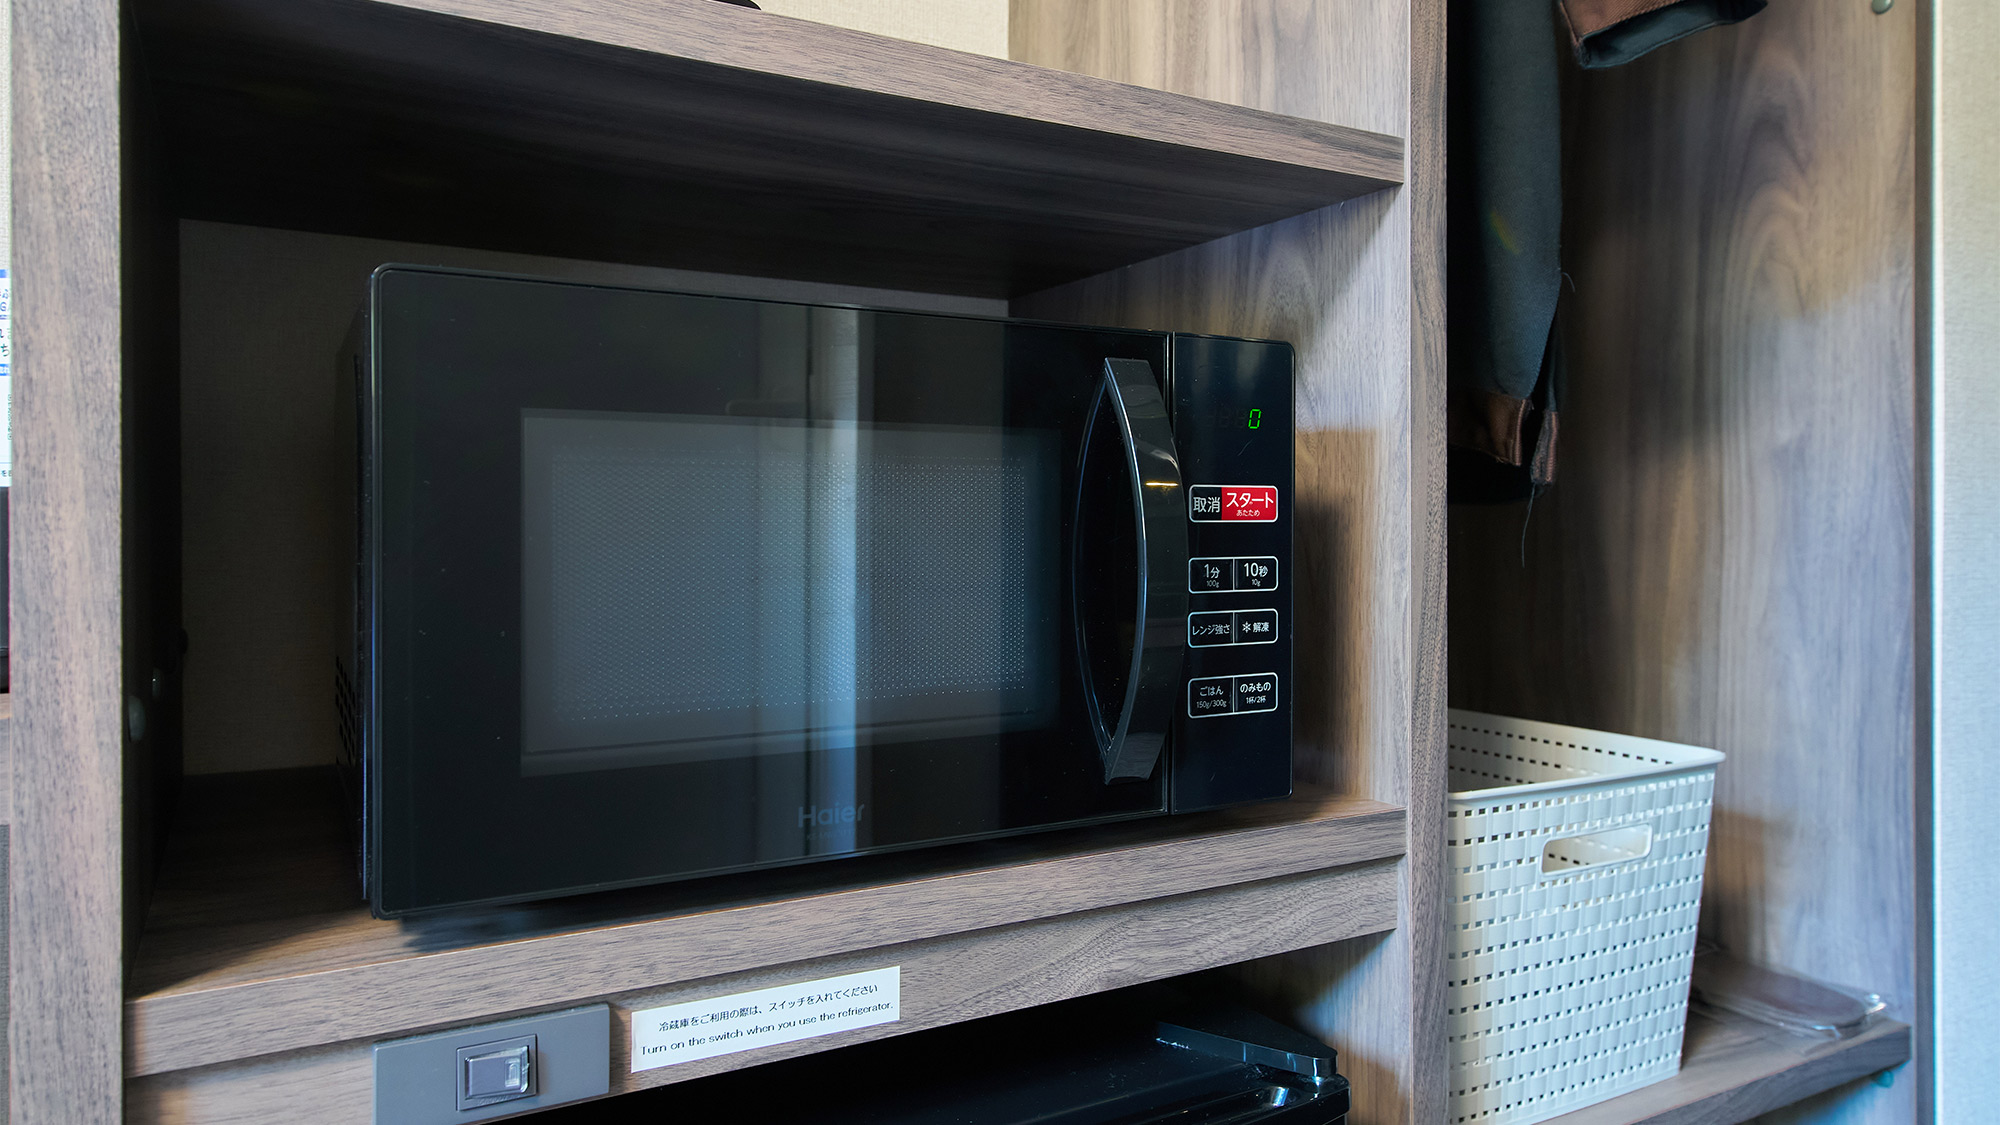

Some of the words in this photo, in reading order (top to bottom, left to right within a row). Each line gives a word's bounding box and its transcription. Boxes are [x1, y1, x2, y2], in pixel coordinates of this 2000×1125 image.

[1248, 409, 1261, 429] 0
[1193, 496, 1220, 513] 取消
[1226, 492, 1274, 508] スタート
[1236, 509, 1260, 517] あたため
[1203, 563, 1220, 579] 1分
[1243, 562, 1269, 578] 10秒
[1206, 580, 1219, 588] 100g
[1251, 578, 1261, 587] 10g
[1192, 624, 1231, 636] レンジ強さ
[1199, 685, 1224, 697] ごはん
[1239, 681, 1272, 694] のみもの
[1196, 699, 1227, 710] 150g/300g
[1245, 694, 1267, 705] 1杯/2杯
[798, 802, 865, 828] Haier
[641, 1043, 667, 1055] Turn
[670, 1040, 685, 1050] on
[688, 1036, 706, 1047] the
[708, 1028, 743, 1043] switch
[746, 1023, 775, 1036] when
[777, 1019, 796, 1031] you
[798, 1015, 817, 1026] use
[819, 1011, 836, 1022] the
[837, 1001, 894, 1020] refrigerator.
